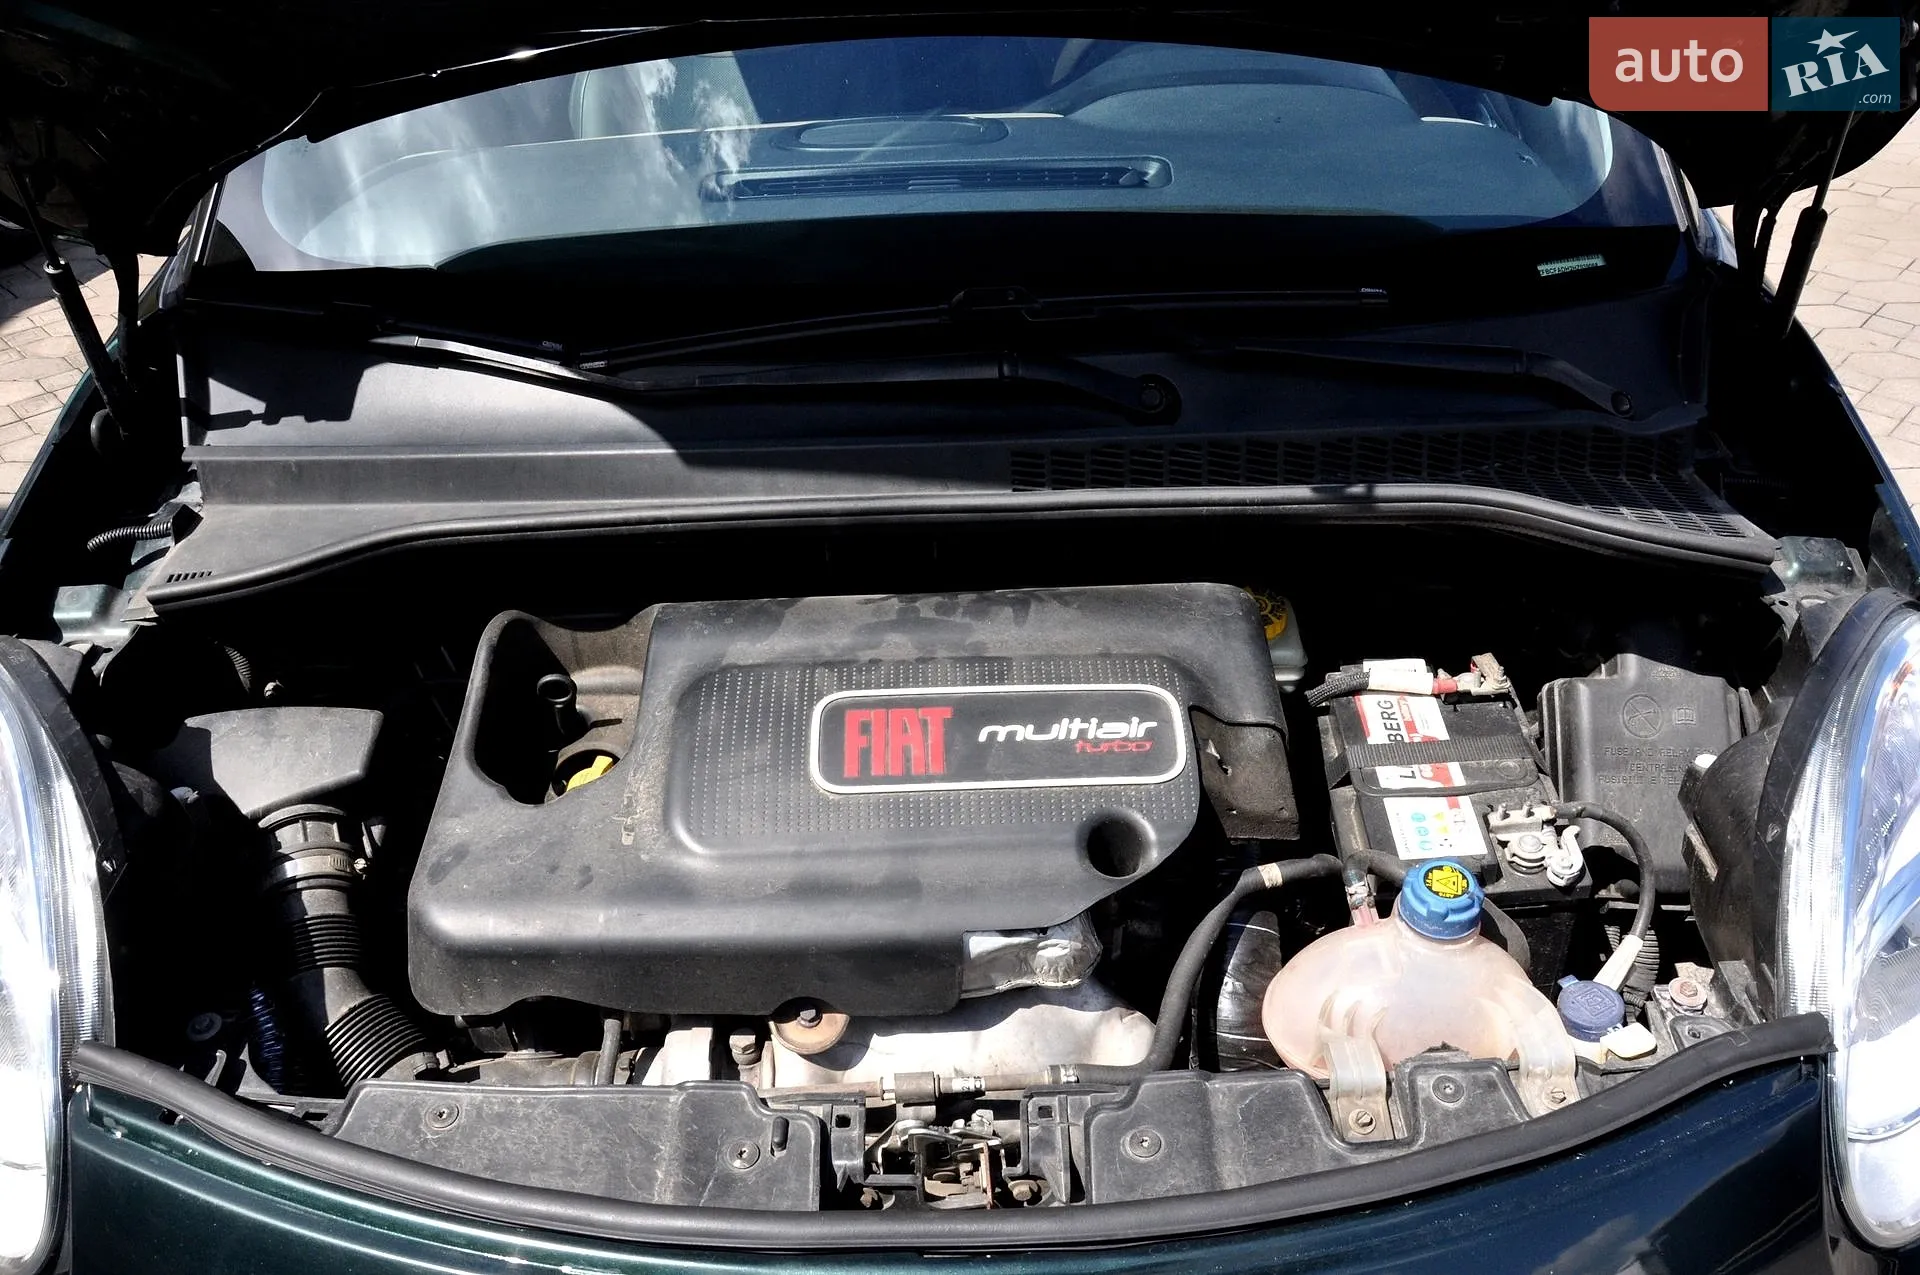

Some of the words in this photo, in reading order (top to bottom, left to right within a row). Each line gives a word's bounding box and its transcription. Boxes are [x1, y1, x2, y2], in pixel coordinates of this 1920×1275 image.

[843, 706, 953, 778] FIAT
[978, 717, 1158, 742] multiair
[1077, 740, 1154, 754] turbo
[1604, 746, 1629, 757] FUSE
[1660, 746, 1690, 757] RELAY
